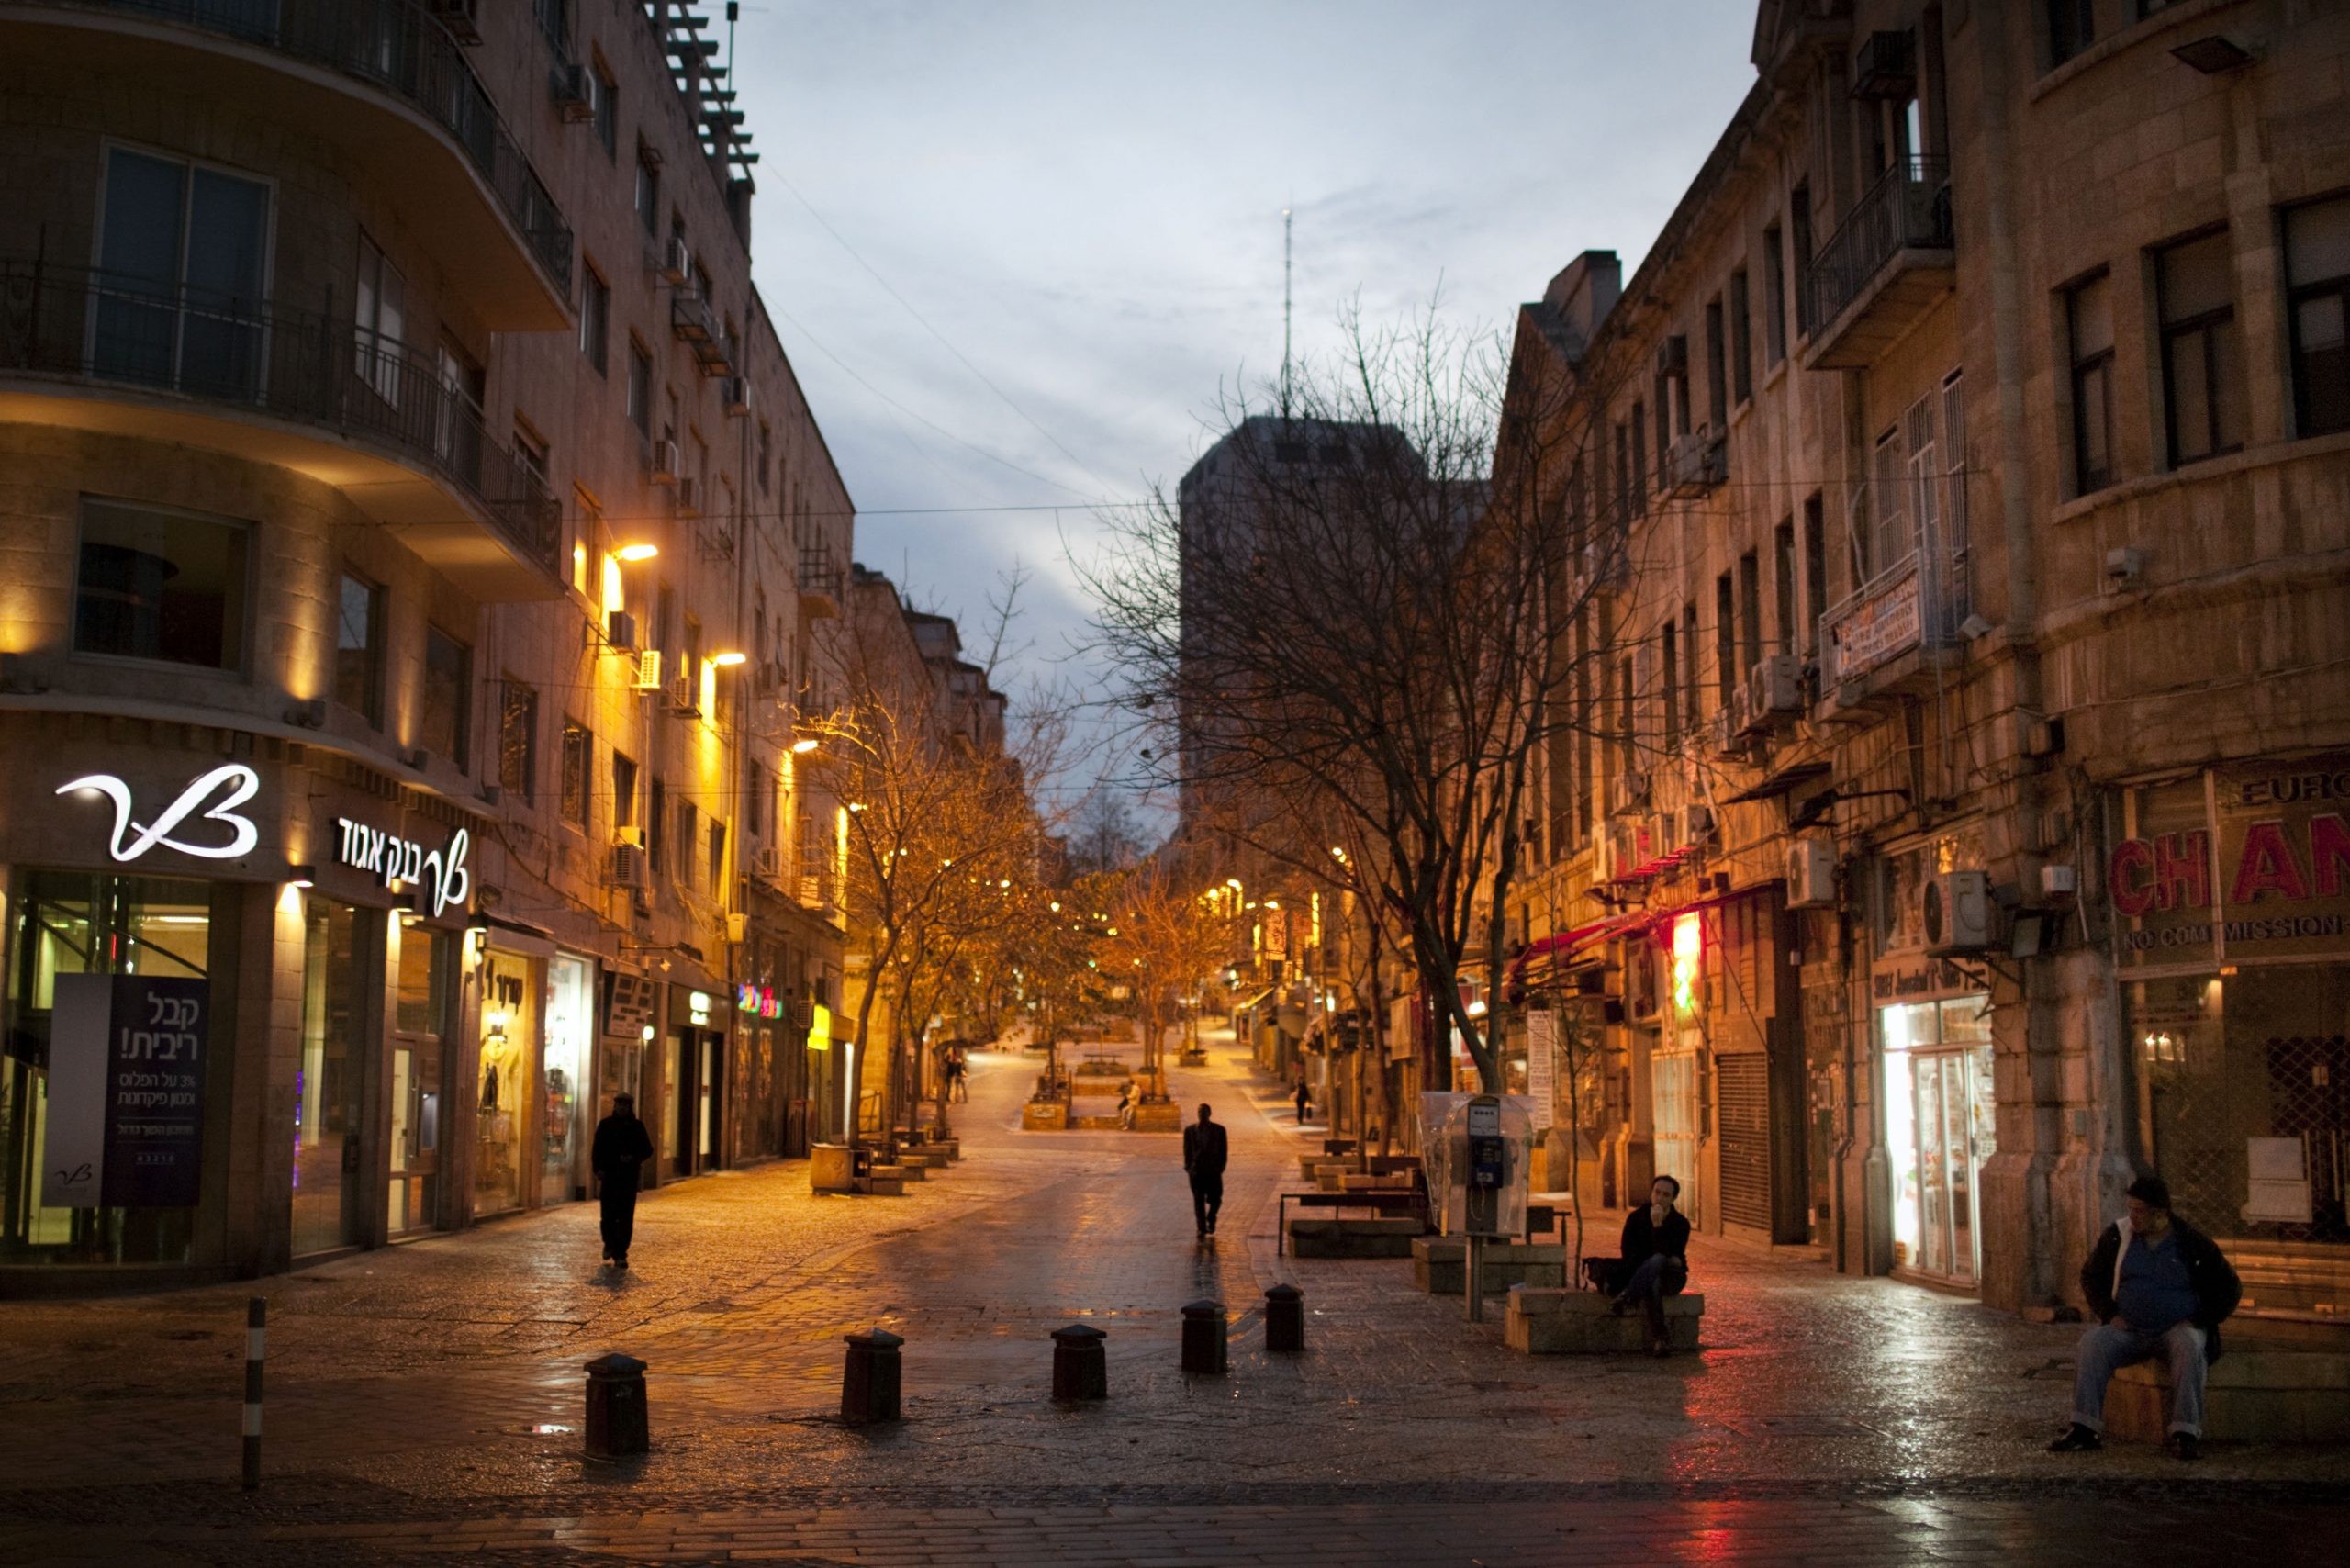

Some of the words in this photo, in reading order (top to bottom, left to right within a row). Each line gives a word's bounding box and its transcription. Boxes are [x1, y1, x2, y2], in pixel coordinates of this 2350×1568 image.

[338, 816, 385, 874] אגוד
[386, 835, 421, 888] בנק
[2123, 930, 2155, 950] NO
[147, 991, 199, 1030] קבל
[120, 1027, 197, 1060] ריבית!
[118, 1070, 158, 1087] הפלוס
[161, 1070, 177, 1087] על
